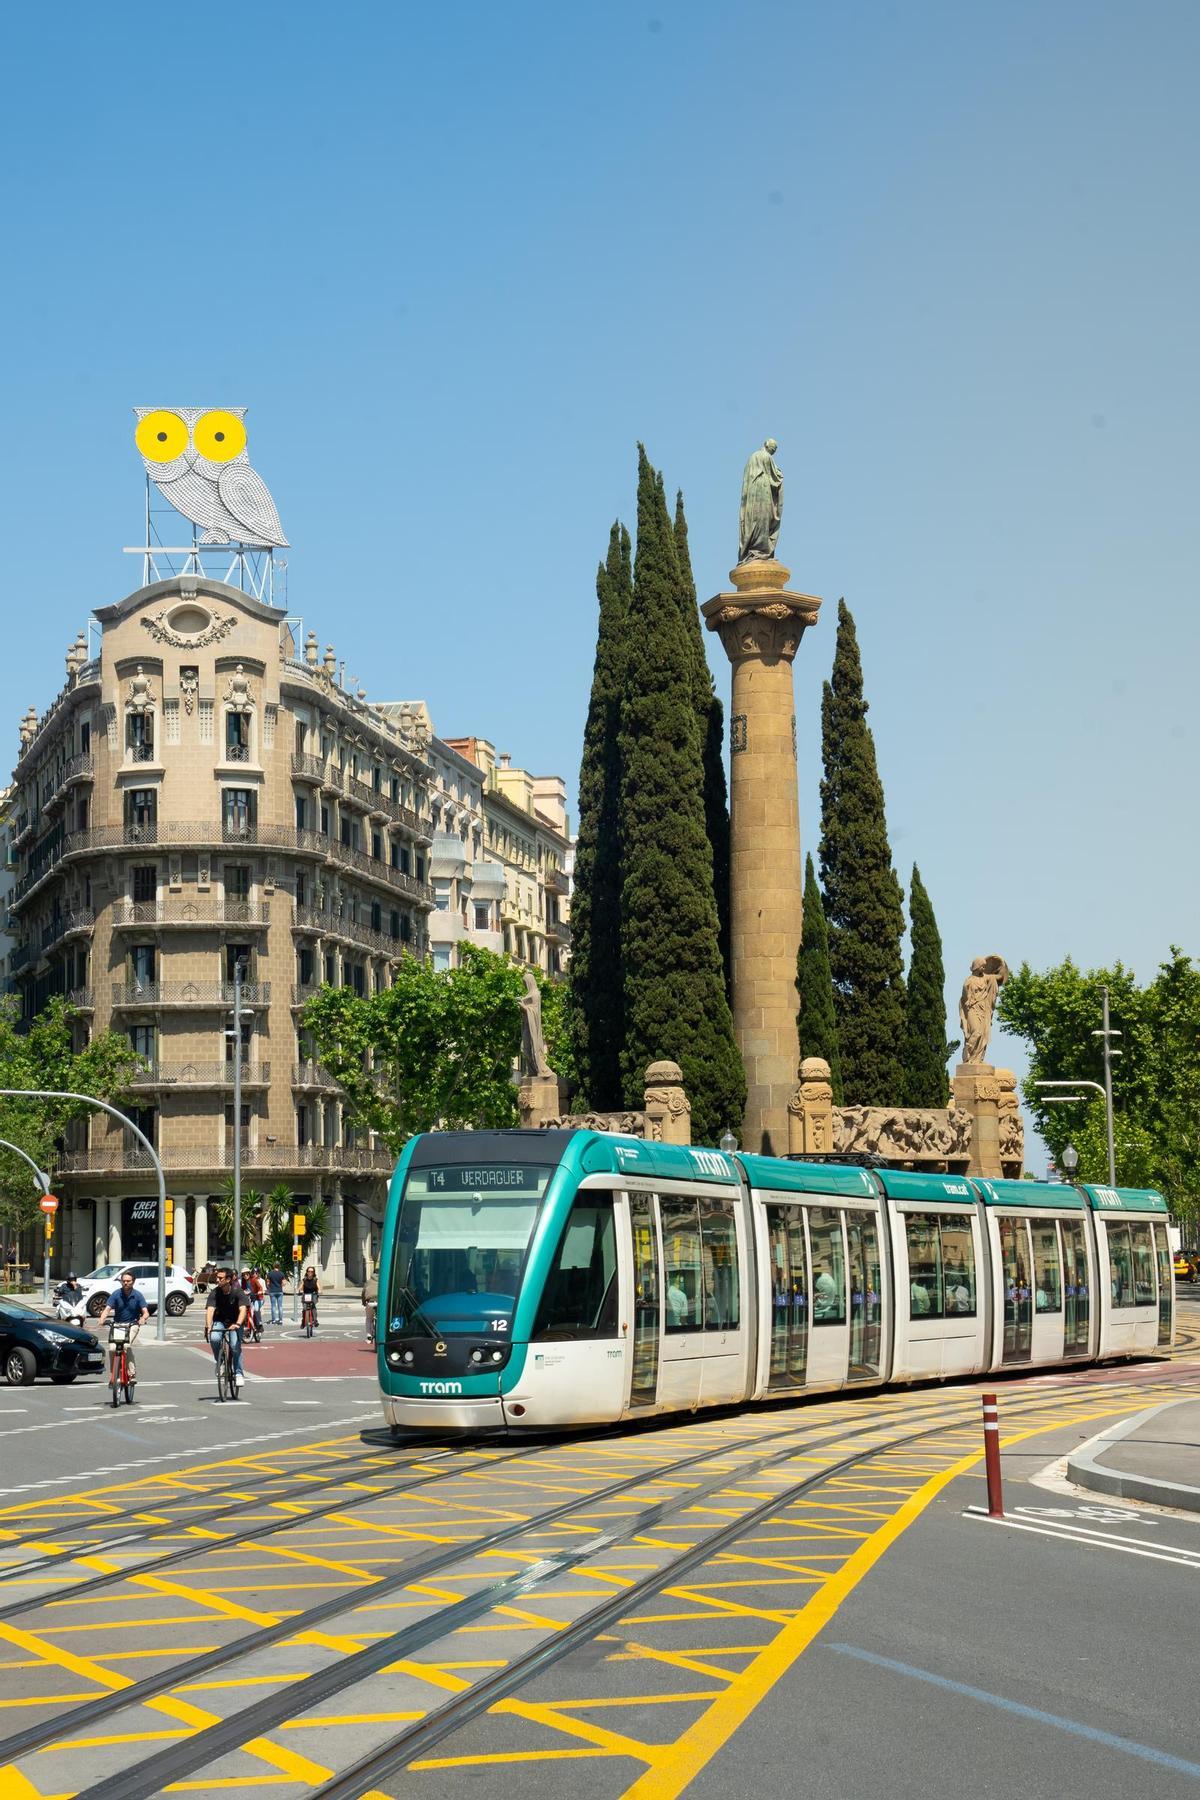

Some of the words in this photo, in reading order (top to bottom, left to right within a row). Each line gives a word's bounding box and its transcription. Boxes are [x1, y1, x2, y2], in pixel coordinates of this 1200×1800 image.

[430, 1172, 446, 1186] T4
[461, 1170, 524, 1186] VERDAGUER
[133, 1201, 157, 1210] CREP
[131, 1210, 156, 1219] NOVA
[491, 1319, 508, 1332] 12
